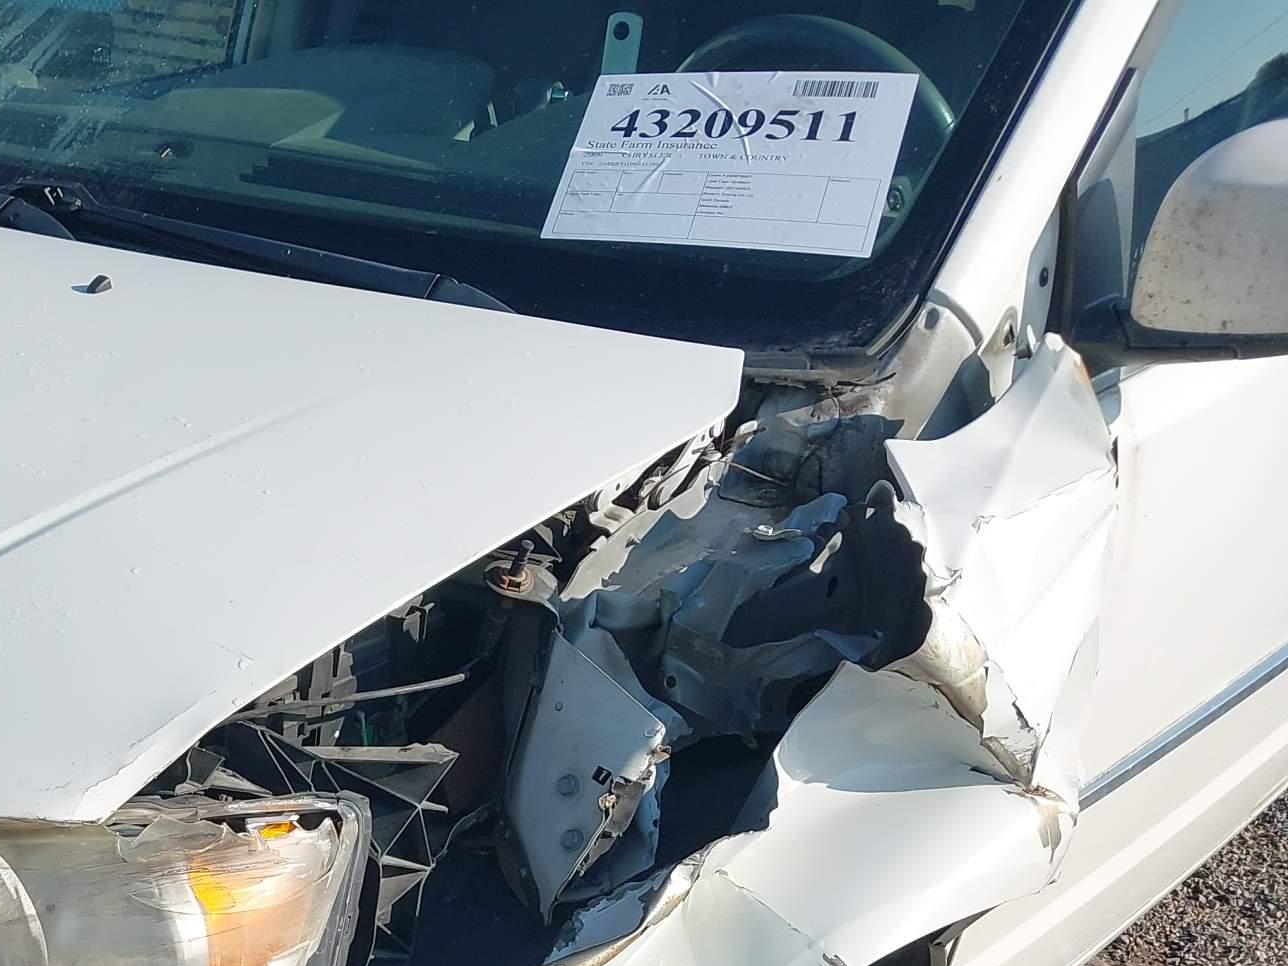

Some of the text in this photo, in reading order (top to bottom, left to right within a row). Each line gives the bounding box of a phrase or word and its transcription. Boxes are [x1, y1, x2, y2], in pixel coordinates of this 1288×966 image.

[611, 108, 857, 142] 43209511
[587, 140, 718, 150] State Farm Insurance
[699, 152, 729, 160] TOWN
[740, 153, 789, 161] COUNTRY
